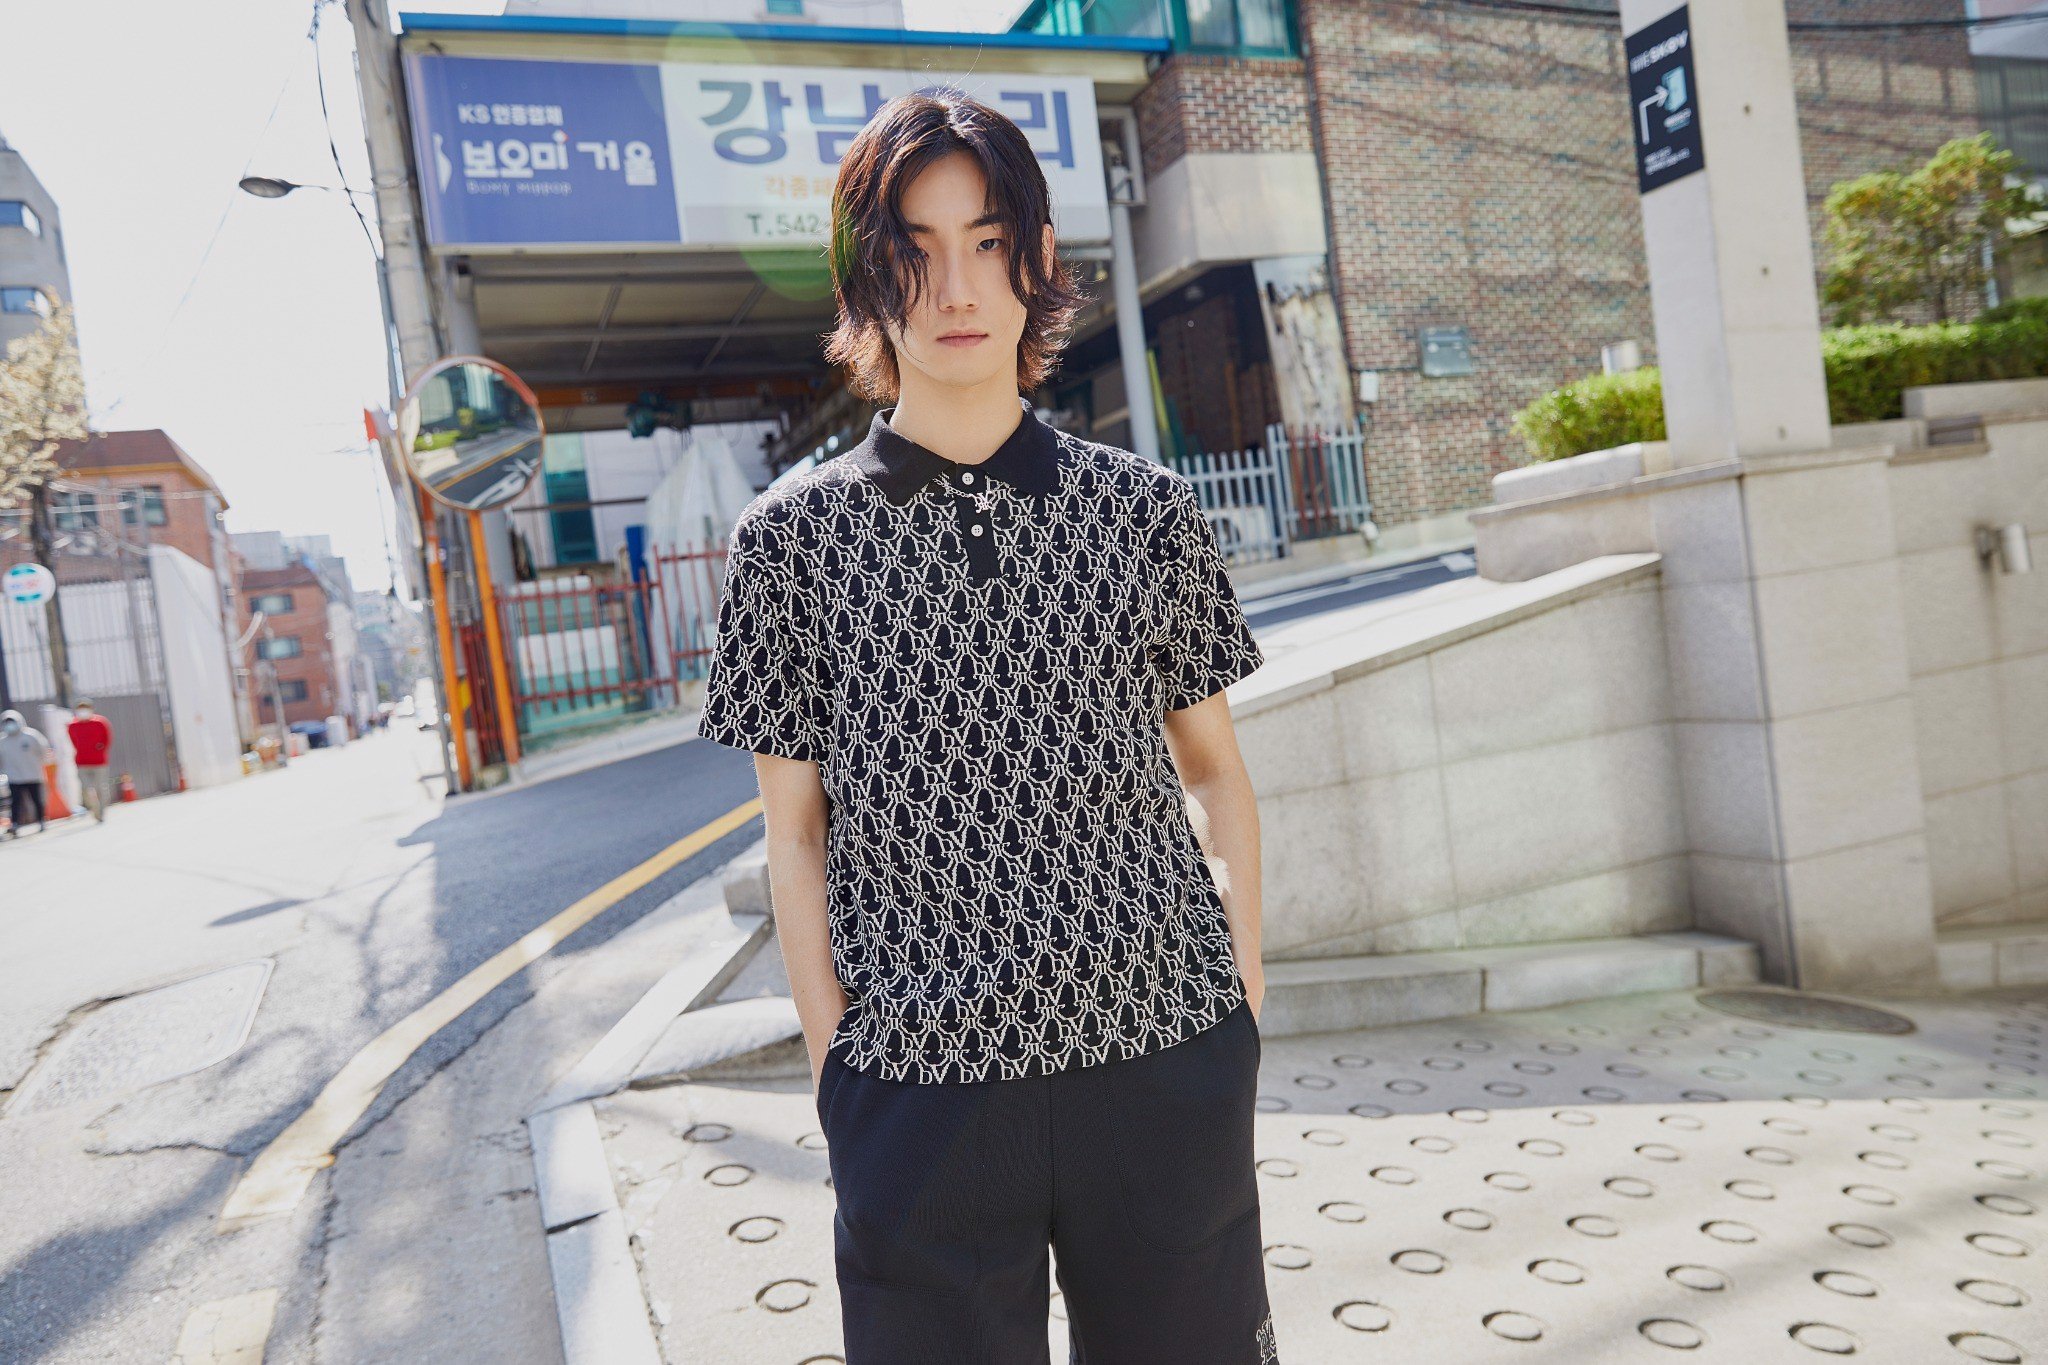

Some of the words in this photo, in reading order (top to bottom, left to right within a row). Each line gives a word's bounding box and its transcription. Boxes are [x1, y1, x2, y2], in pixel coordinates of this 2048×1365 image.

[458, 103, 491, 125] KS
[699, 80, 1074, 169] 강남리
[461, 131, 569, 179] 보오미
[576, 139, 658, 187] 거울
